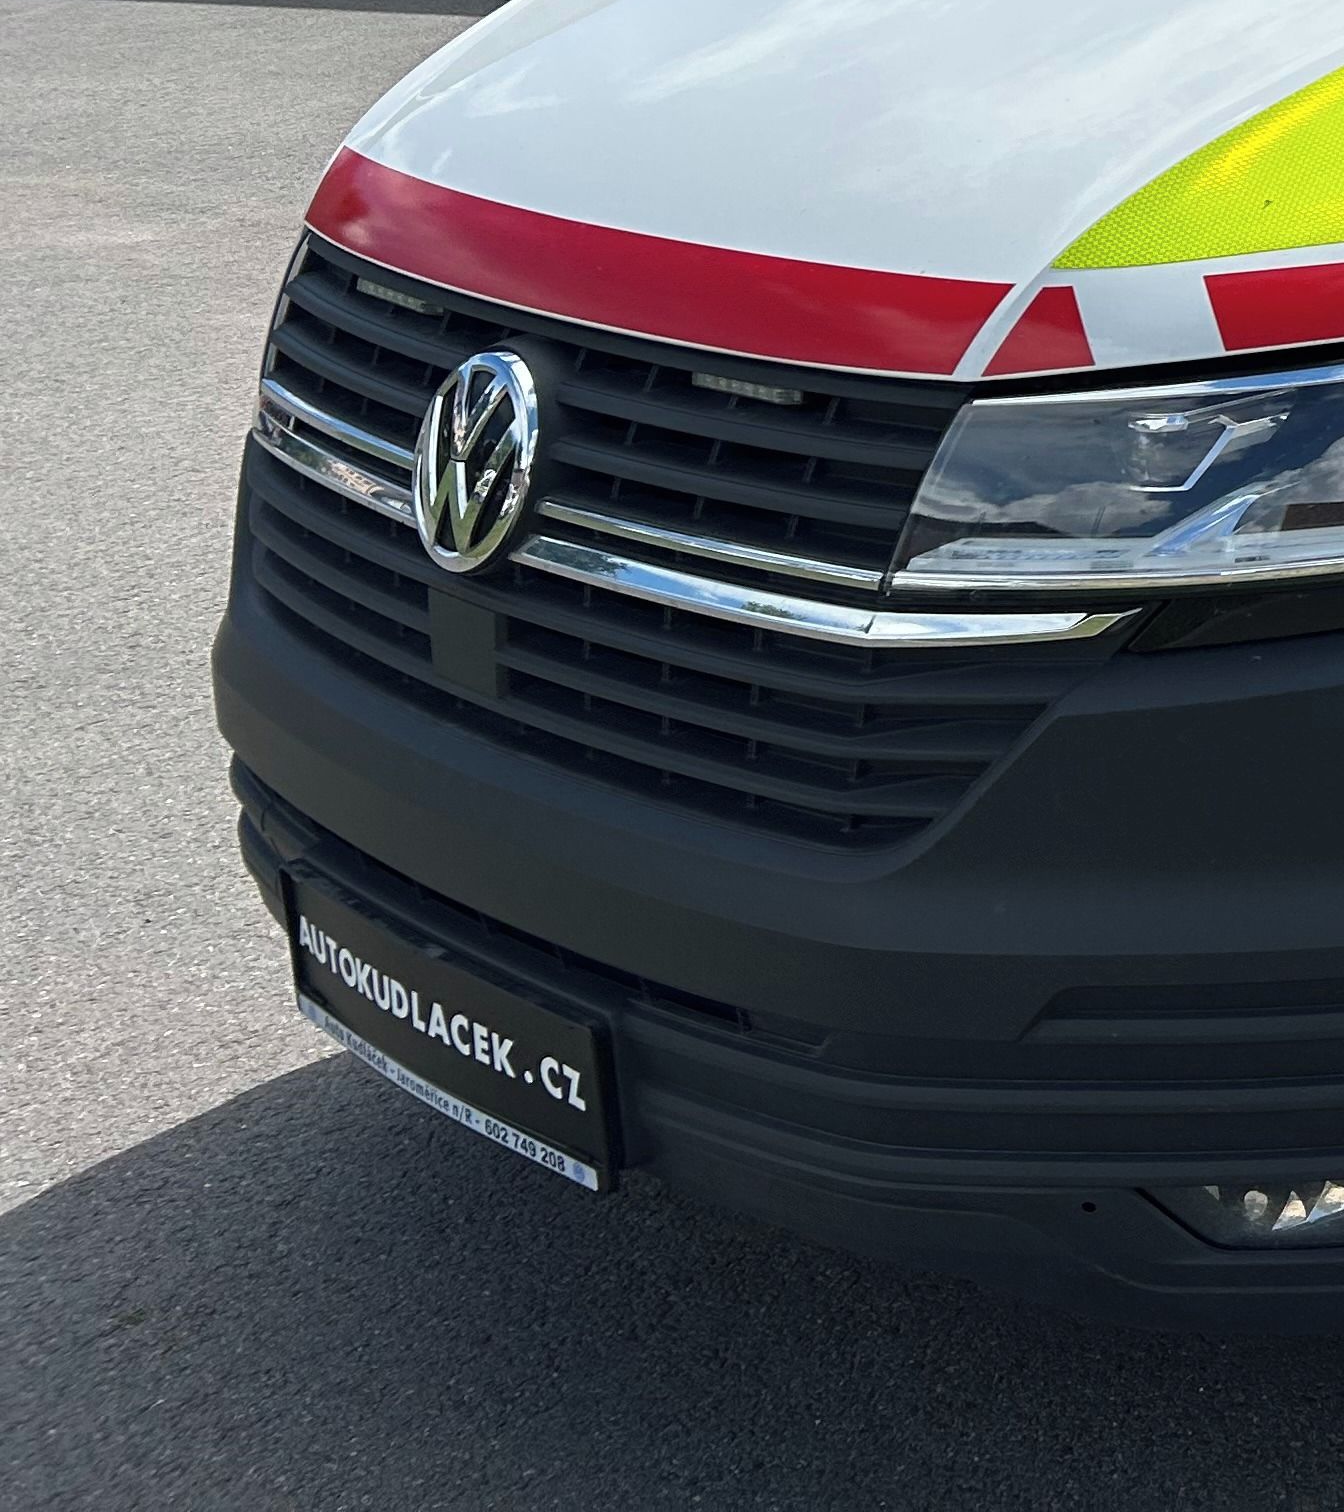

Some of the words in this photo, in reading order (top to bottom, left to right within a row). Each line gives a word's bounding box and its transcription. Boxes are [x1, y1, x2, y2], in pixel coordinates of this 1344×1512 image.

[300, 915, 587, 1112] AUTOKUDLACEK.CZ
[484, 1118, 509, 1145] 602
[512, 1133, 537, 1158] 749
[540, 1147, 566, 1172] 208
